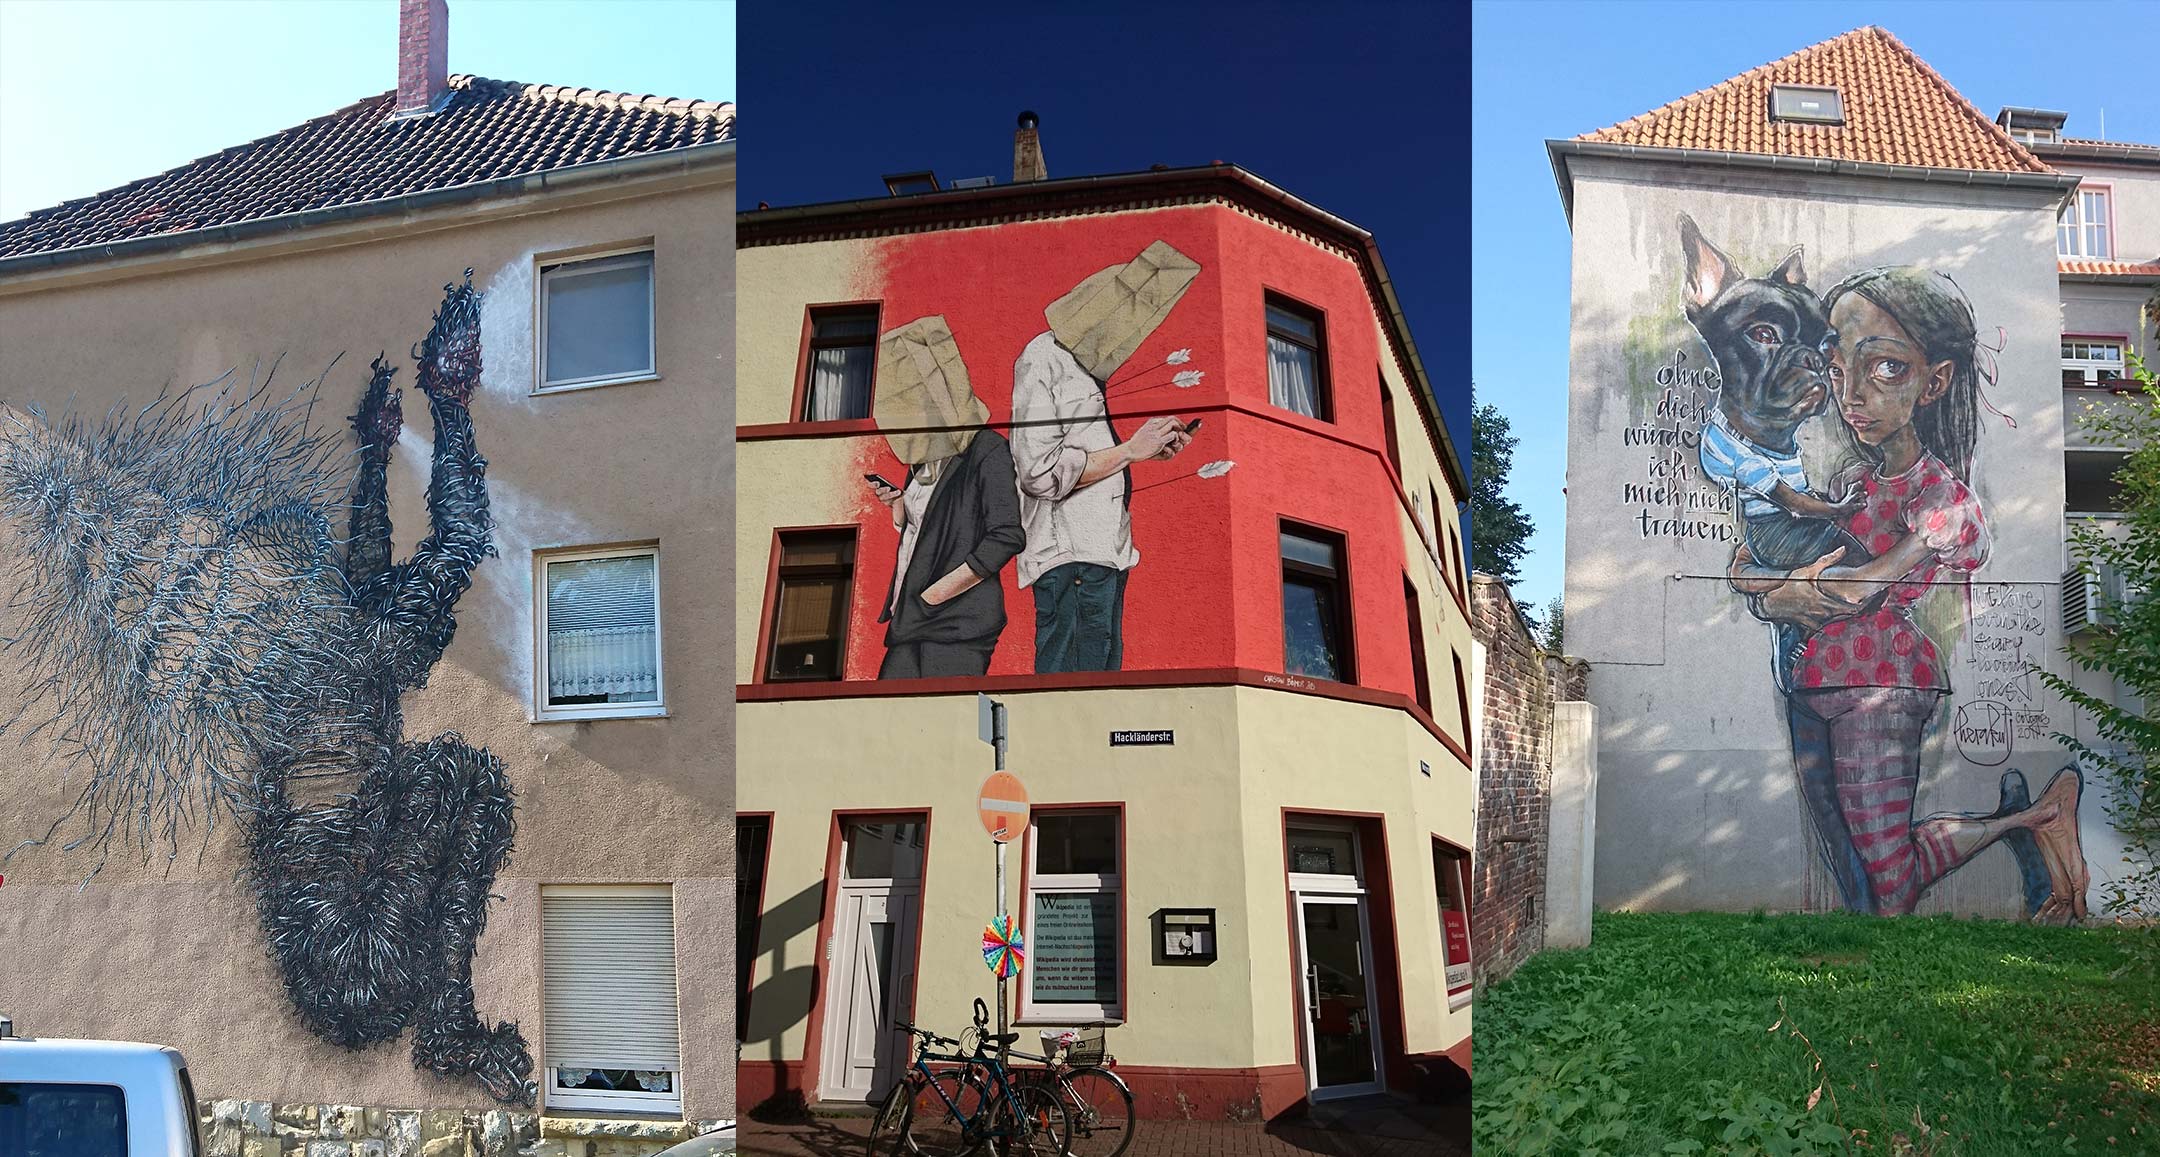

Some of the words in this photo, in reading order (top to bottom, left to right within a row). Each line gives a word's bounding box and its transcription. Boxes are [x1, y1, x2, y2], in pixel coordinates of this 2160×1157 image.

[1656, 348, 1722, 392] ohne
[1656, 389, 1712, 424] dich
[1624, 422, 1702, 449] würde
[1649, 449, 1697, 480] ich
[1624, 477, 1687, 506] mich
[1687, 476, 1741, 522] nicht
[1635, 508, 1739, 544] trauen.
[1998, 584, 2042, 609] love
[1114, 731, 1171, 742] Hackländerstr.
